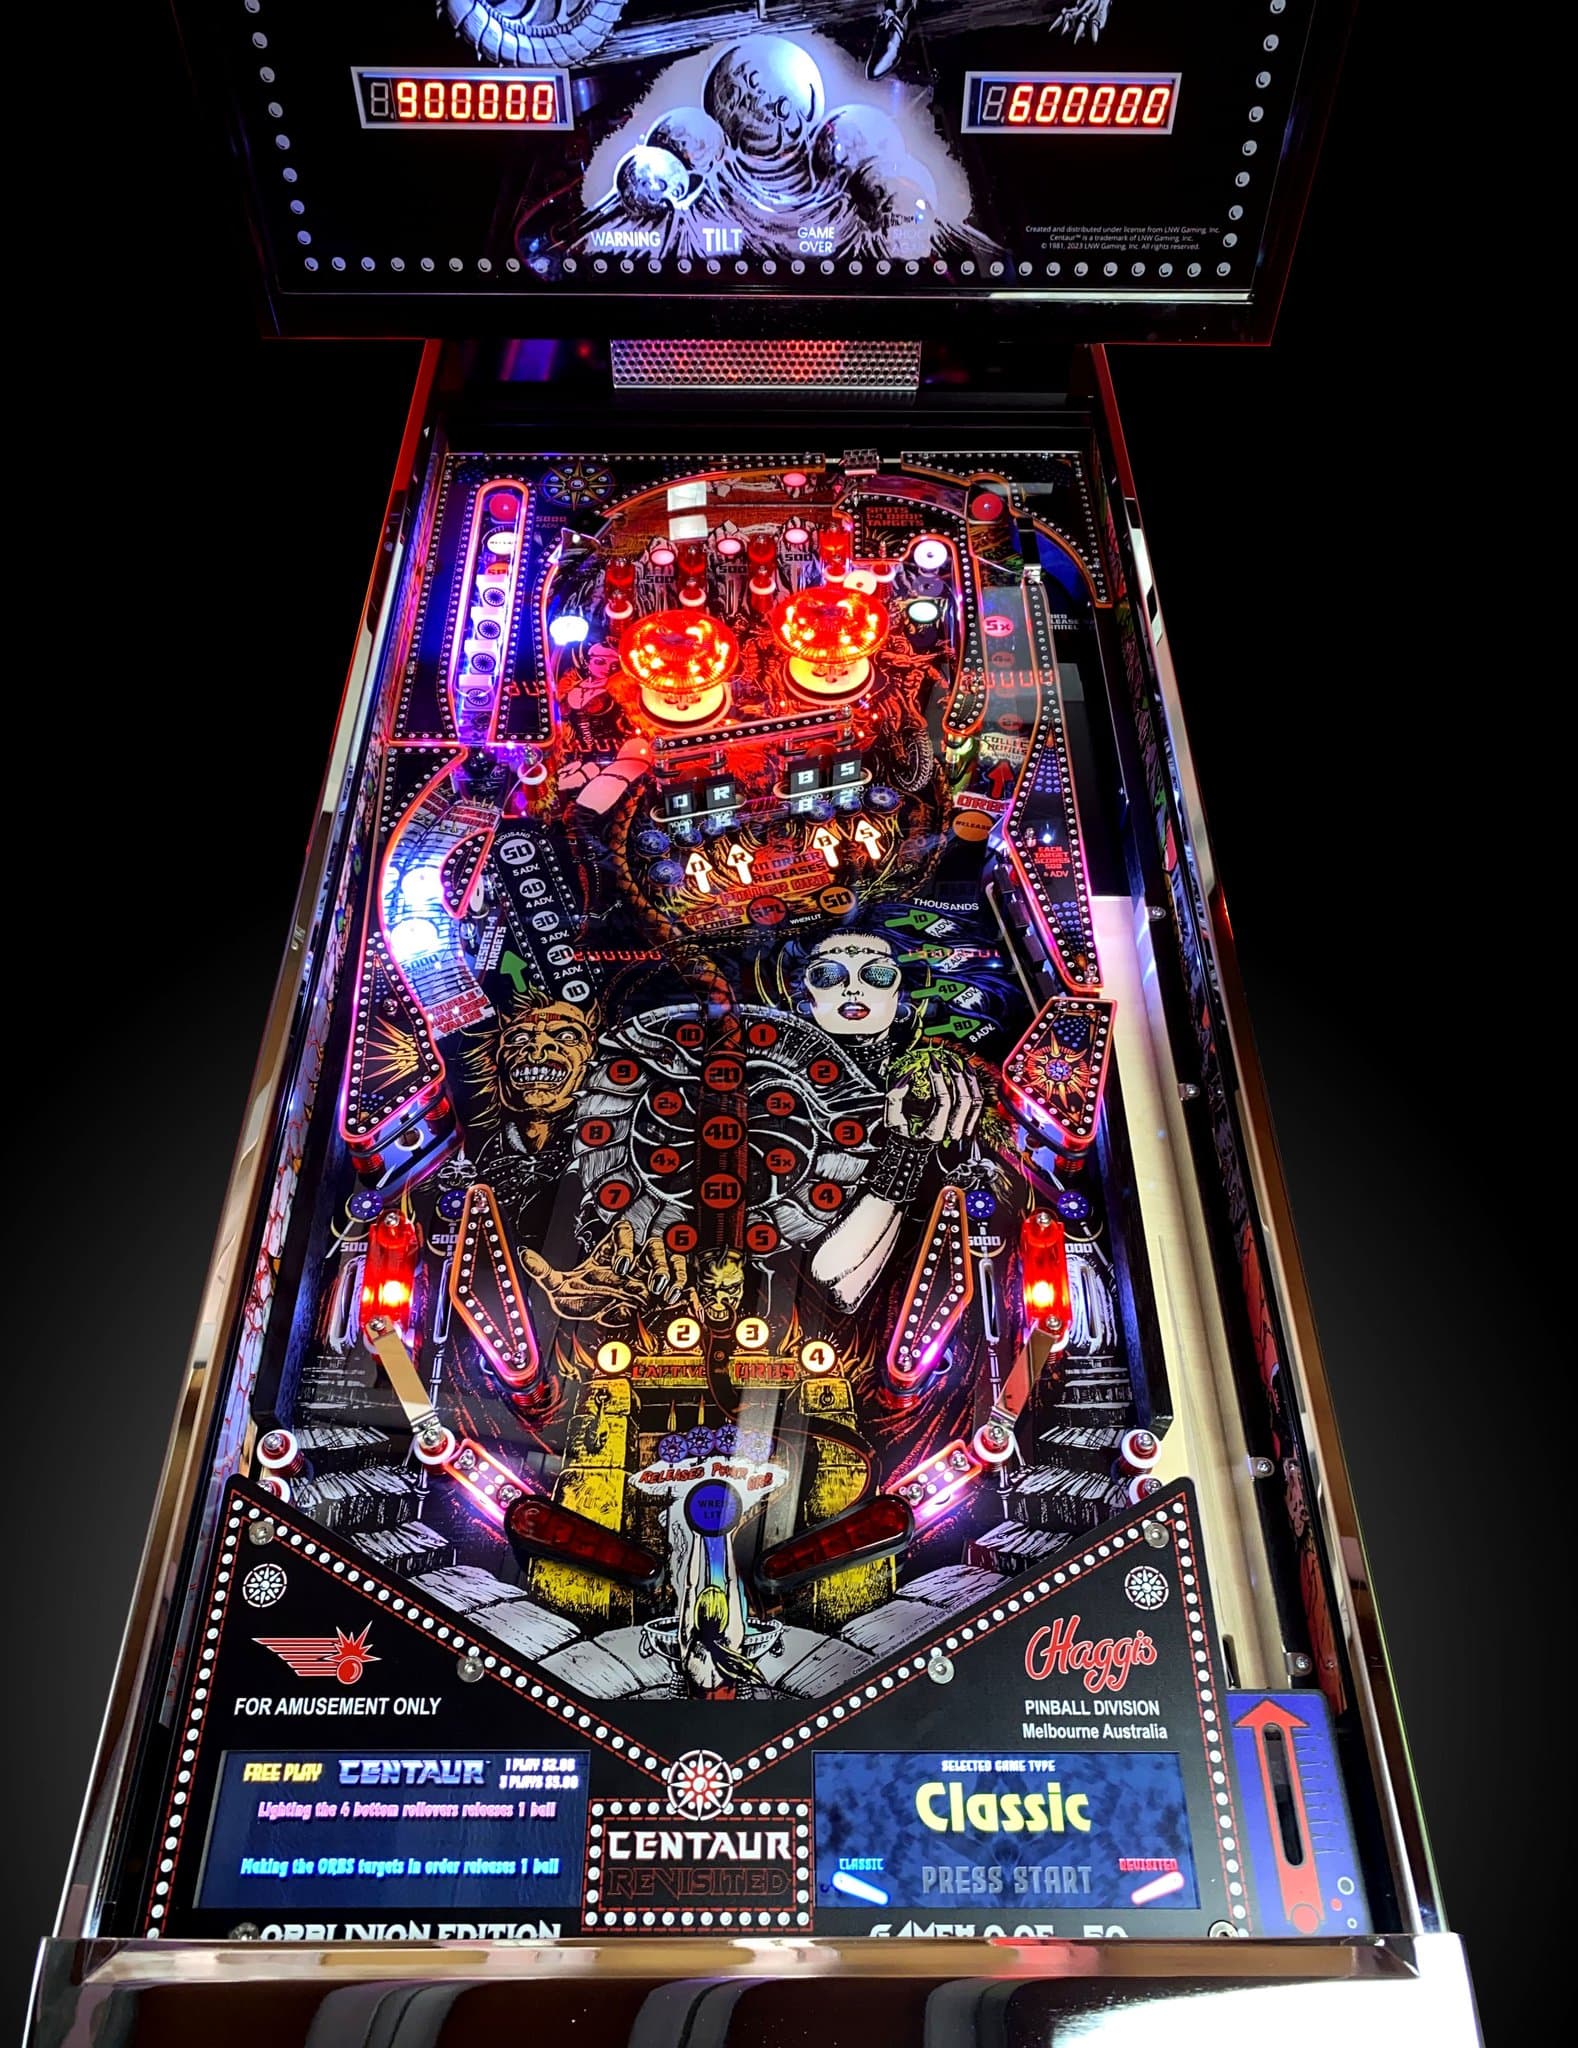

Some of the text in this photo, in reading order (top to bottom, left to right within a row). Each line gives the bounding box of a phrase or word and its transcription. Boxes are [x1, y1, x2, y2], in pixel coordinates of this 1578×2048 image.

[397, 82, 553, 120] 900000
[1008, 86, 1171, 123] 600000
[797, 227, 835, 239] GAME
[1025, 225, 1052, 233] Created
[1066, 225, 1102, 233] distributed
[591, 231, 661, 247] WARNING
[702, 228, 743, 252] TILT
[799, 241, 833, 253] OVER
[985, 619, 1011, 632] 5x
[798, 770, 815, 784] B
[713, 786, 731, 800] R
[494, 830, 531, 846] THOUSAND
[504, 844, 533, 861] 50
[771, 851, 824, 869] ORDER
[513, 863, 541, 877] 5 ADV.
[752, 862, 826, 884] RELEASES
[1050, 870, 1069, 878] ADV
[521, 881, 545, 895] 40
[526, 895, 555, 909] 4 ADV.
[822, 891, 851, 909] 50
[913, 897, 980, 911] THOUSANDS
[750, 906, 786, 920] SPL
[789, 913, 822, 925] WHEN LIT
[913, 914, 929, 924] 10
[534, 915, 557, 928] 30
[474, 916, 498, 970] RESETS 1-4
[540, 929, 571, 945] 3 ADV.
[485, 926, 507, 971] TARGETS
[549, 949, 573, 963] 20
[401, 954, 439, 973] 5000
[553, 964, 583, 980] 2 ADV.
[567, 984, 586, 998] 10
[938, 982, 958, 993] 40
[961, 986, 979, 1001] ADV.
[953, 1020, 973, 1031] 80
[681, 1028, 701, 1042] 10
[759, 1028, 766, 1042] 1
[969, 1023, 996, 1043] 8 ADV.
[617, 1065, 631, 1079] 9
[709, 1066, 740, 1083] 20
[817, 1065, 831, 1079] 2
[658, 1097, 678, 1109] 2x
[771, 1097, 790, 1109] 3x
[589, 1125, 604, 1139] 8
[705, 1123, 739, 1140] 40
[842, 1126, 856, 1140] 3
[653, 1154, 676, 1166] 4x
[770, 1154, 791, 1167] 5x
[608, 1190, 623, 1204] 7
[704, 1182, 739, 1199] 60
[819, 1189, 834, 1203] 4
[676, 1230, 690, 1244] 6
[756, 1231, 769, 1244] 5
[677, 1325, 690, 1341] 2
[745, 1325, 758, 1341] 3
[611, 1348, 617, 1366] 1
[809, 1348, 824, 1365] 4
[632, 1365, 706, 1379] CAPTIVE
[734, 1363, 796, 1380] ORBS
[639, 1466, 705, 1484] RELEASES
[1025, 1614, 1158, 1694] Haggis
[234, 1697, 442, 1716] FOR AMUSEMENT ONLY
[1025, 1700, 1160, 1716] PINBALL DIVISION
[1022, 1723, 1168, 1739] Melbourne Australia
[506, 1759, 512, 1772] 1
[512, 1758, 541, 1772] PLAY
[941, 1760, 1056, 1772] SELECTED GAME TYPE
[243, 1763, 323, 1782] FREE PLAY
[509, 1775, 543, 1789] PLAYS
[258, 1801, 557, 1820] Lighting the 4 bottom rollovers releases 1 ball
[915, 1782, 1092, 1832] Classic
[607, 1831, 792, 1860] CENTAUR
[240, 1857, 289, 1878] Making
[292, 1858, 315, 1874] the
[358, 1858, 405, 1877] targets
[407, 1857, 421, 1874] in
[425, 1857, 460, 1875] order
[463, 1857, 516, 1875] releases
[521, 1857, 528, 1874] 1
[533, 1857, 560, 1875] ball
[839, 1858, 884, 1871] CLASSIC
[1119, 1858, 1178, 1871] REVISITED
[607, 1867, 791, 1899] REVISITED
[922, 1866, 1092, 1894] PRESS START
